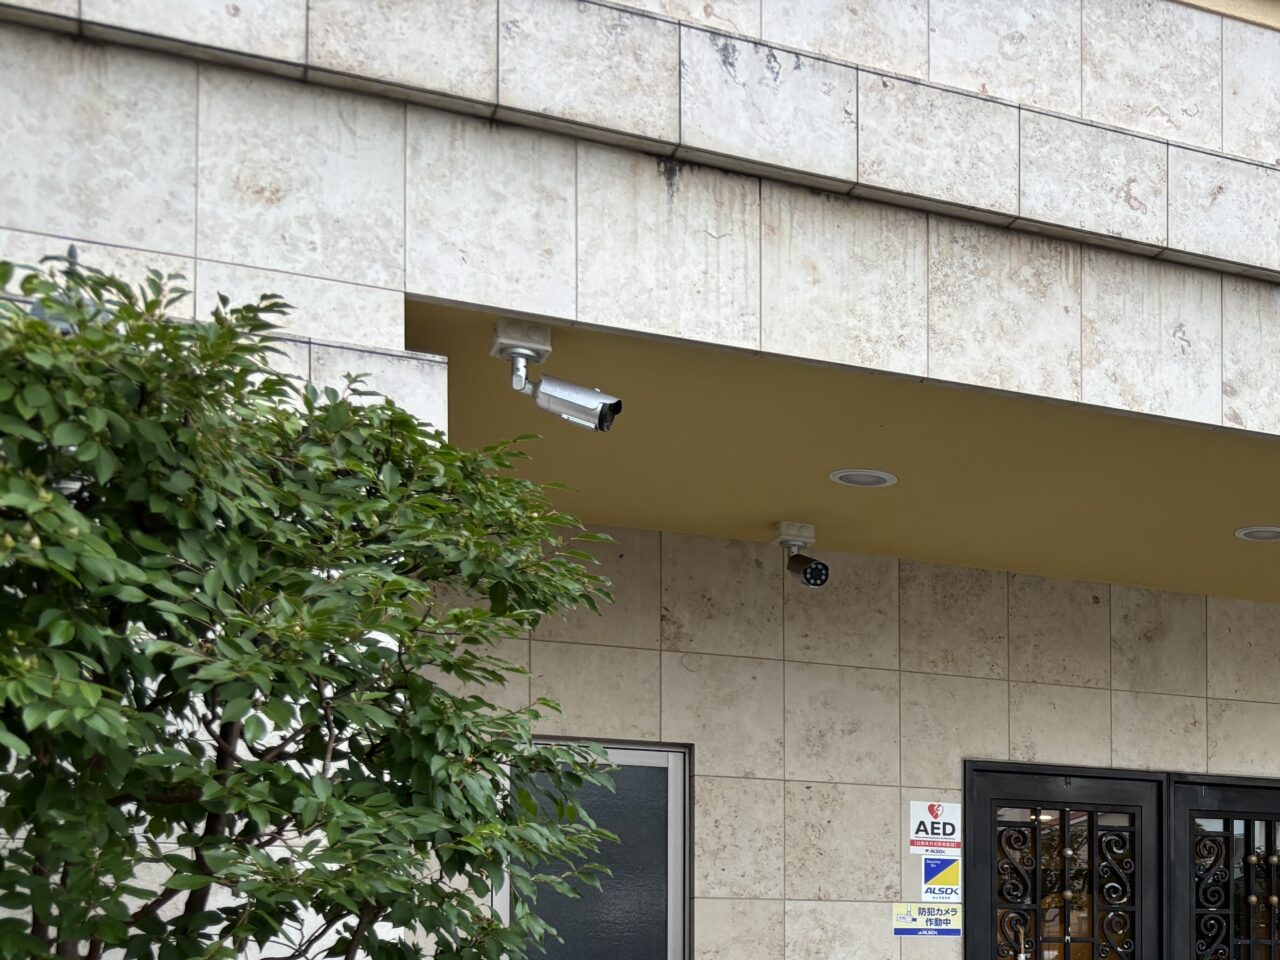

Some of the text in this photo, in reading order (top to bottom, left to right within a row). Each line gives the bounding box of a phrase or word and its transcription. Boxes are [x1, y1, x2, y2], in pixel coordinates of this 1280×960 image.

[915, 820, 956, 836] AED
[924, 887, 959, 895] ALSOK
[918, 907, 958, 916] 防犯カメラ
[925, 917, 951, 926] 作動中
